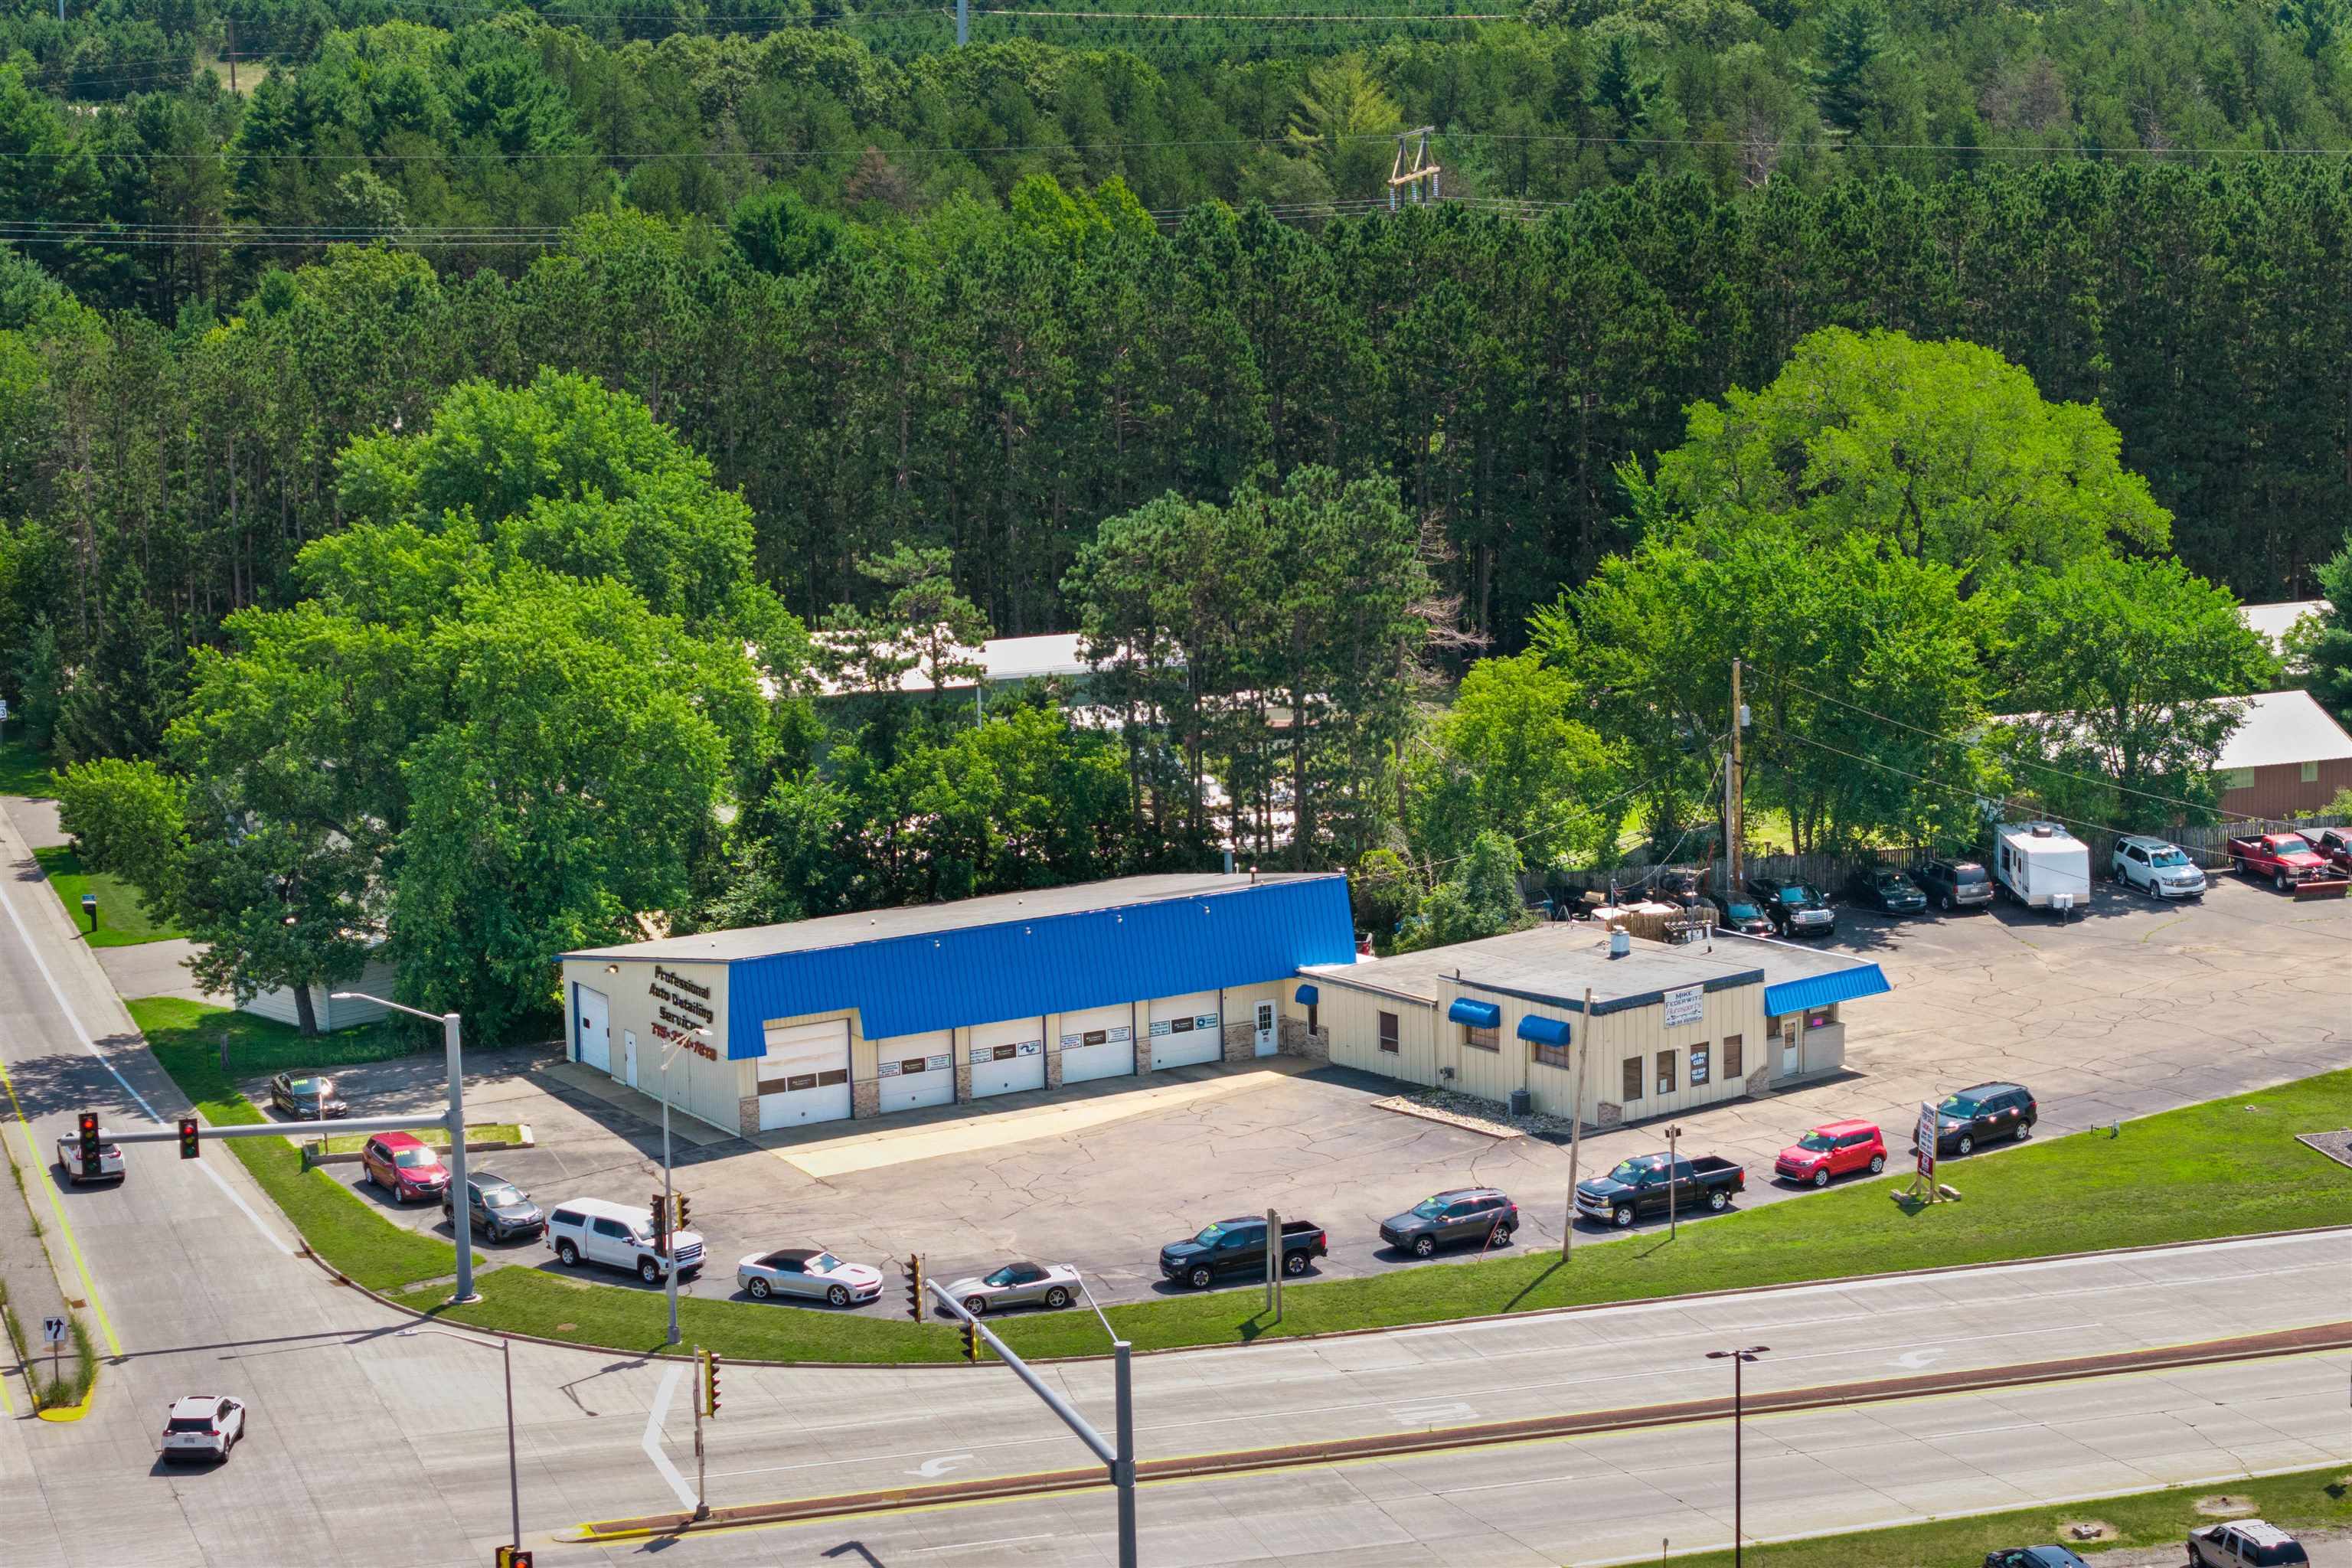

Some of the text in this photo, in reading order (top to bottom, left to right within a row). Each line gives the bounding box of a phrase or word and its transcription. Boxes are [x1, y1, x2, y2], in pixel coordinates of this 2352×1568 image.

[655, 965, 710, 1000] Professional
[1675, 990, 1693, 999] MIKE
[648, 982, 713, 1024] Auto Detailing
[1665, 995, 1702, 1009] FEDERWITZ
